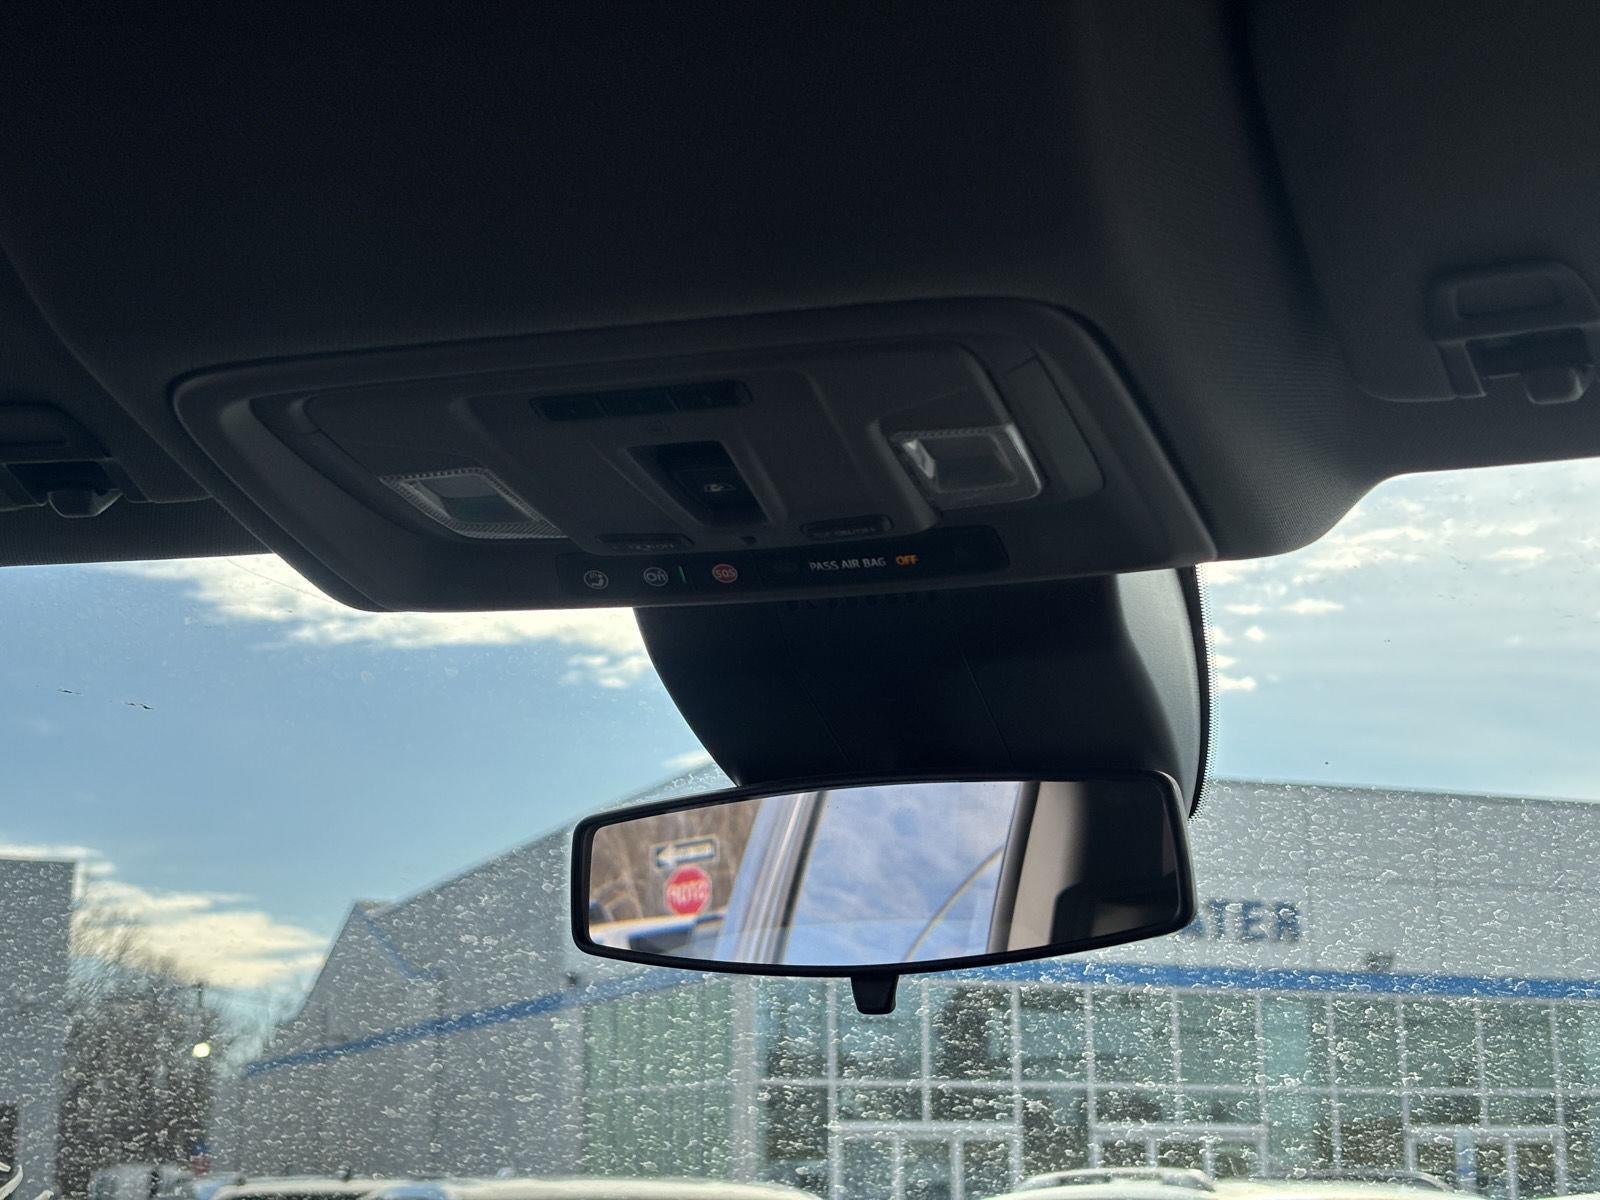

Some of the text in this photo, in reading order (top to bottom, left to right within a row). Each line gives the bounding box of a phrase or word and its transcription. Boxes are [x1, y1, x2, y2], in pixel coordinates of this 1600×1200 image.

[809, 555, 918, 571] PASS AIR BAG OFF
[716, 568, 737, 579] SOS
